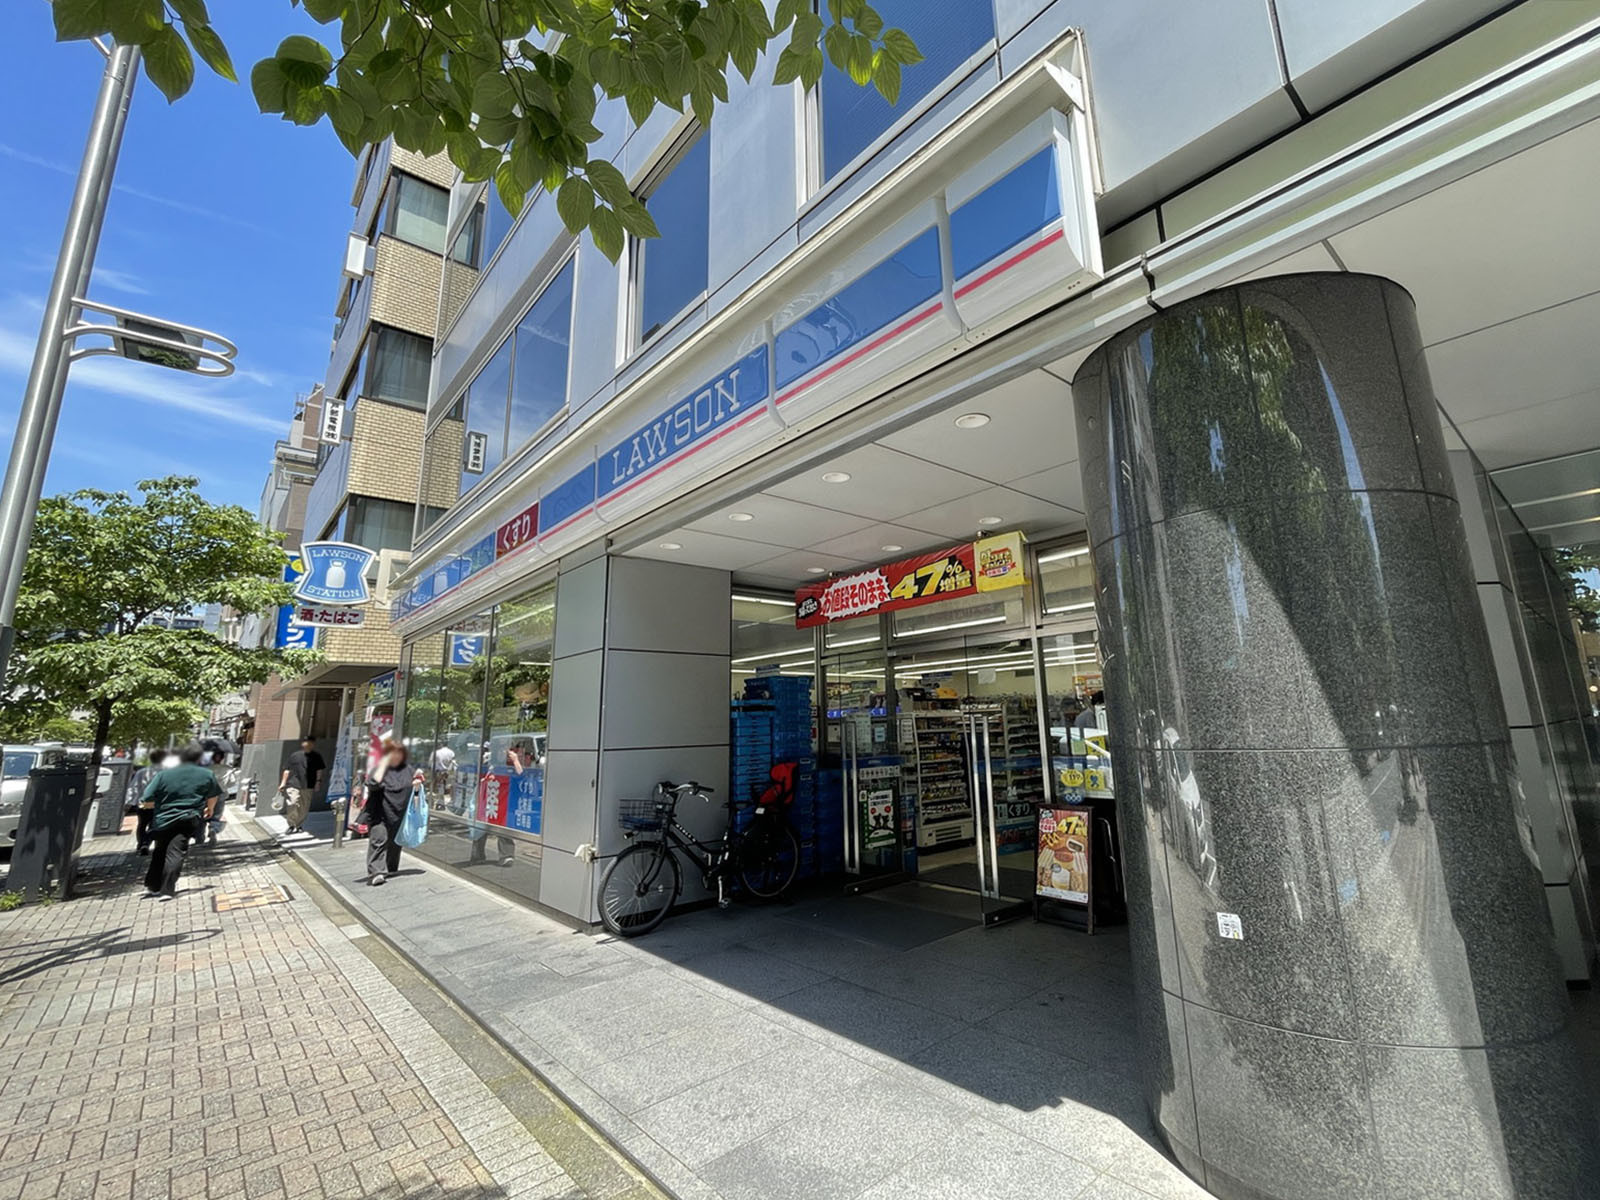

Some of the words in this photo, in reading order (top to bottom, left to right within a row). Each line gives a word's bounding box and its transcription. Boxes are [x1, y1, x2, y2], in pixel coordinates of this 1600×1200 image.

[612, 369, 741, 484] LAWSON
[503, 514, 531, 550] くすり
[312, 549, 365, 562] LAWSON
[306, 585, 360, 598] STATION
[820, 577, 888, 615] お値段そのまま
[301, 608, 360, 624] 酒・たばこ
